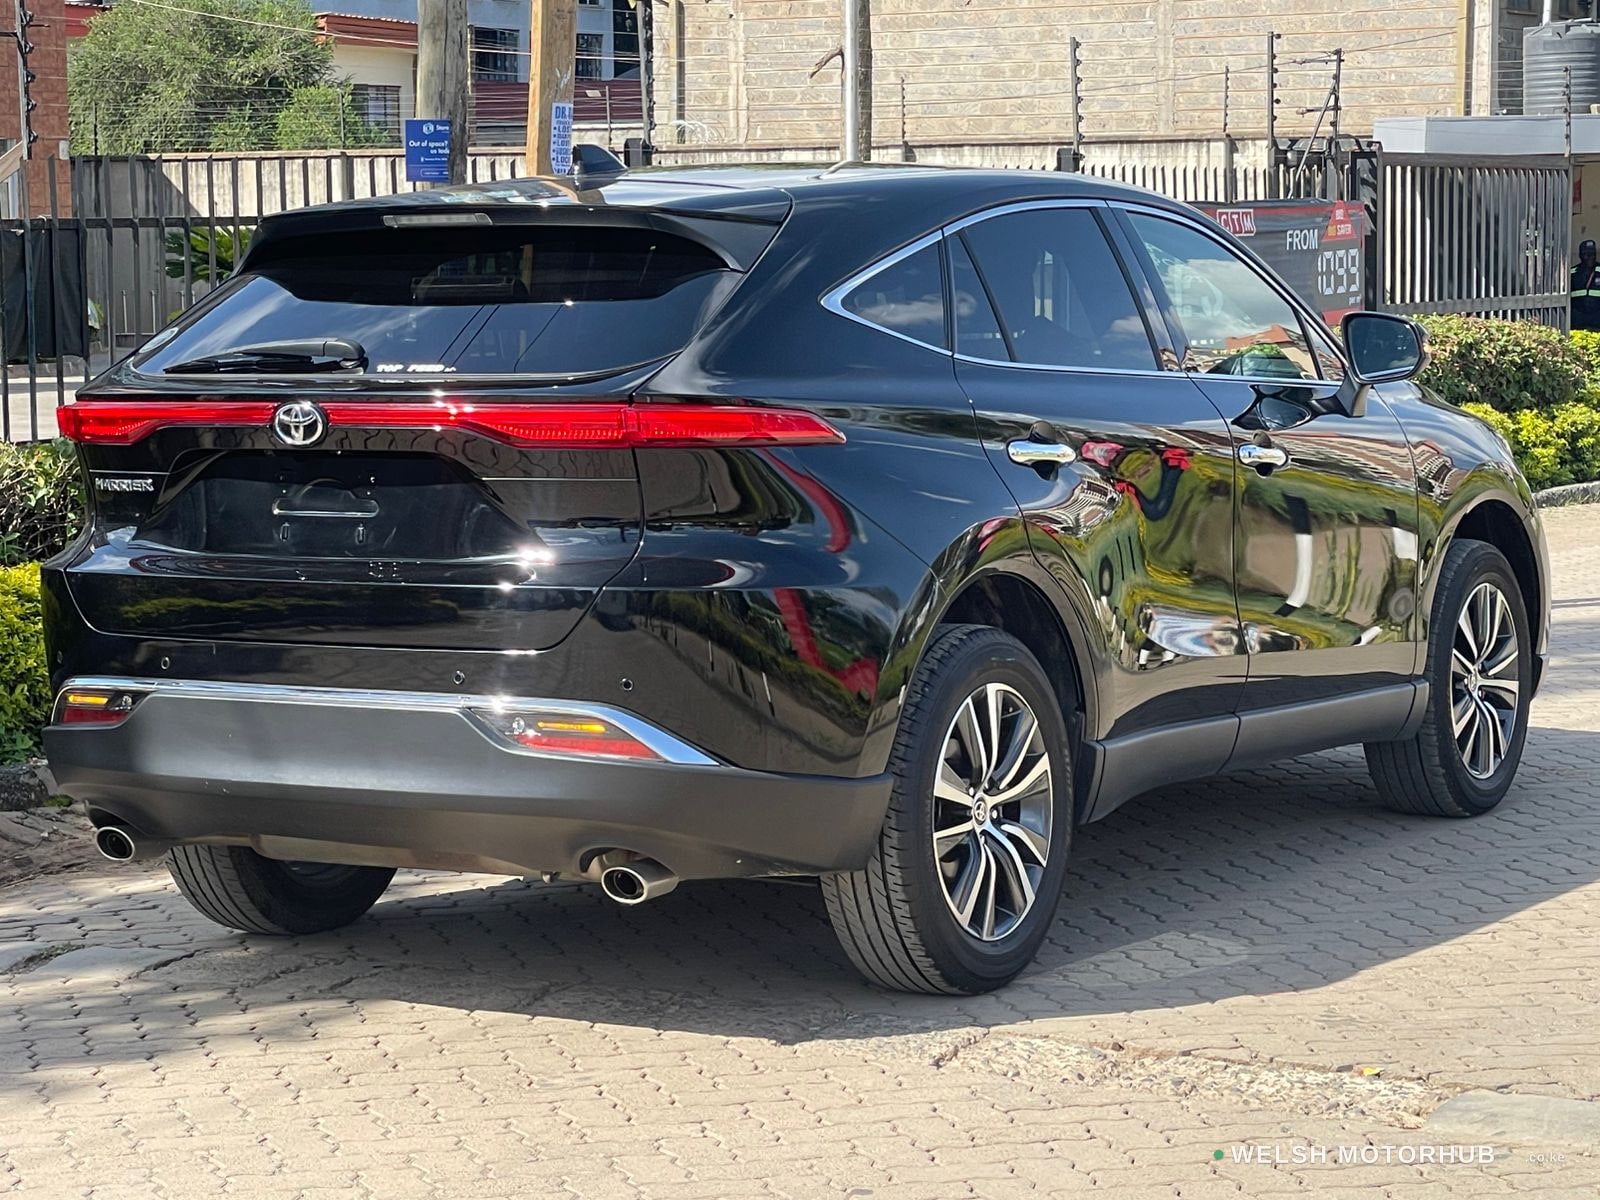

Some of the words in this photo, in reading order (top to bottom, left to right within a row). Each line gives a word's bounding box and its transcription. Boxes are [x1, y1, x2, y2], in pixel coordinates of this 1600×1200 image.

[1219, 211, 1254, 234] CTM
[1286, 229, 1318, 250] FROM
[95, 478, 154, 491] HARRIER
